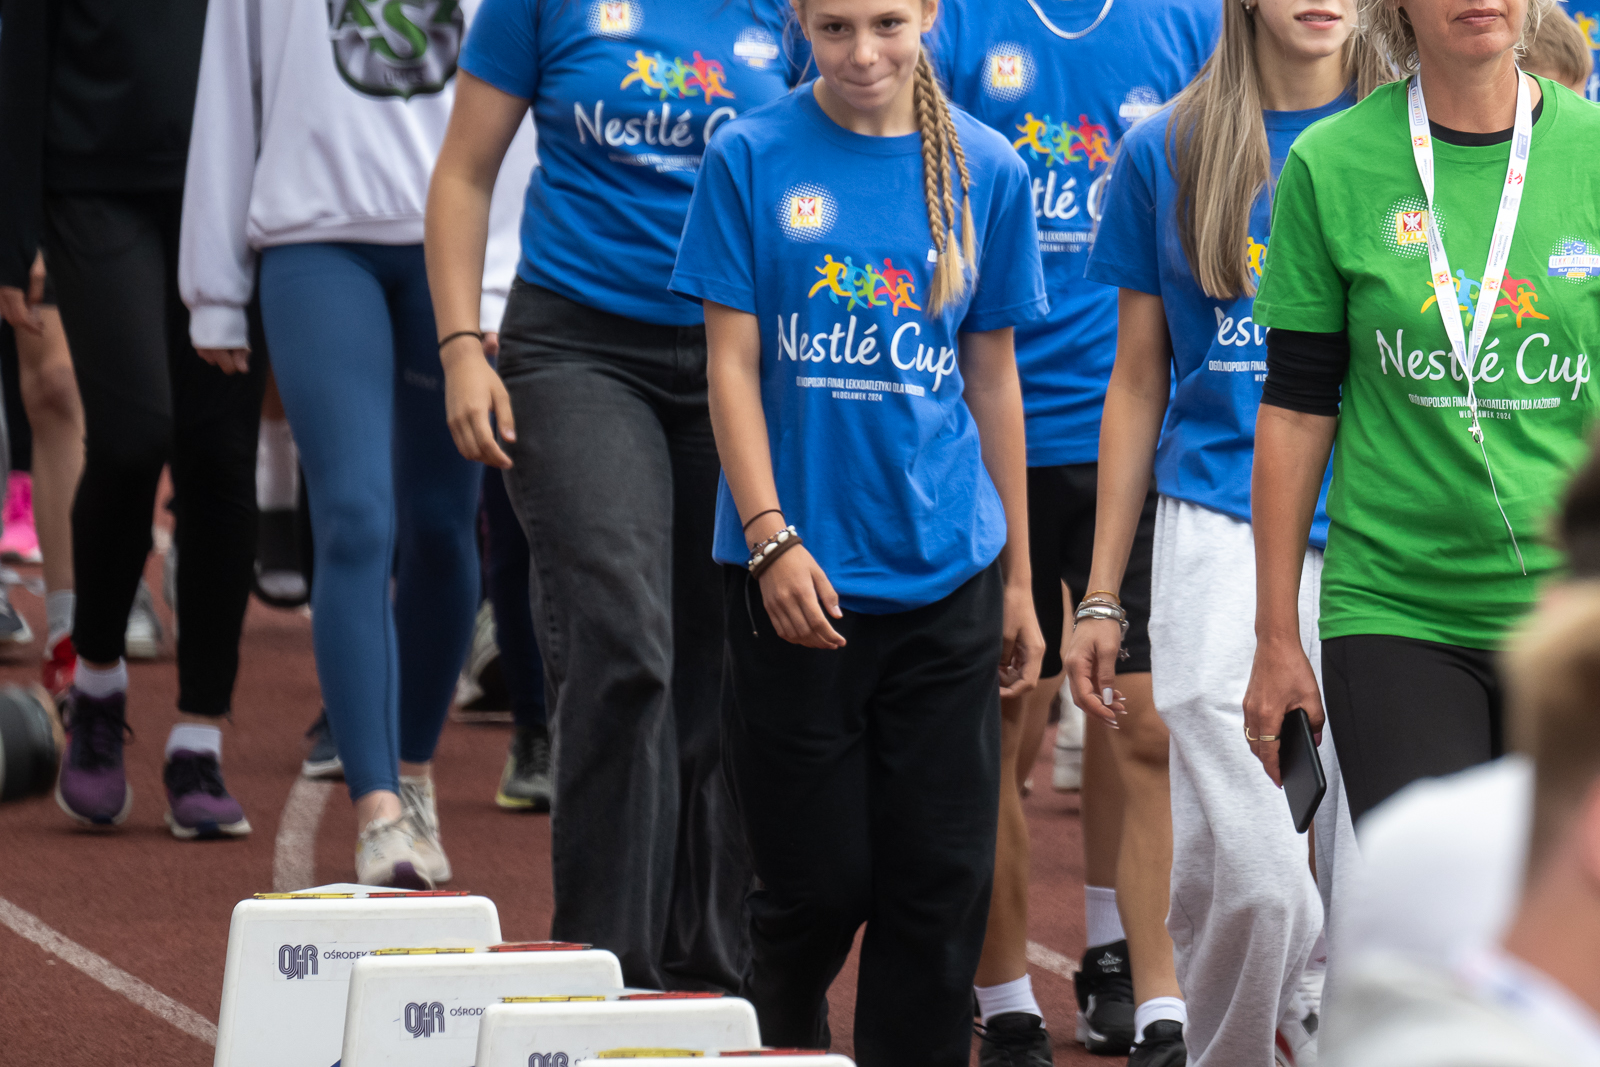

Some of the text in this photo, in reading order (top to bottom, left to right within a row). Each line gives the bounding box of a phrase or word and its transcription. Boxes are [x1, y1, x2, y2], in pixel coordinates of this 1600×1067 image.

[574, 100, 693, 147] Nestlé
[1400, 232, 1427, 242] PZLA
[777, 313, 956, 392] Nestlé Cup
[1208, 359, 1250, 372] OGÓLNOPOLSKI
[1516, 333, 1590, 400] Cup
[867, 393, 883, 402] 2024
[1474, 398, 1521, 410] KKOATLETYKI
[1521, 399, 1532, 410] DLA
[1533, 397, 1561, 410] KAŻDEGO!
[1459, 410, 1511, 420] WŁOŁAWEK 2024
[449, 1006, 486, 1017] OŚROD
